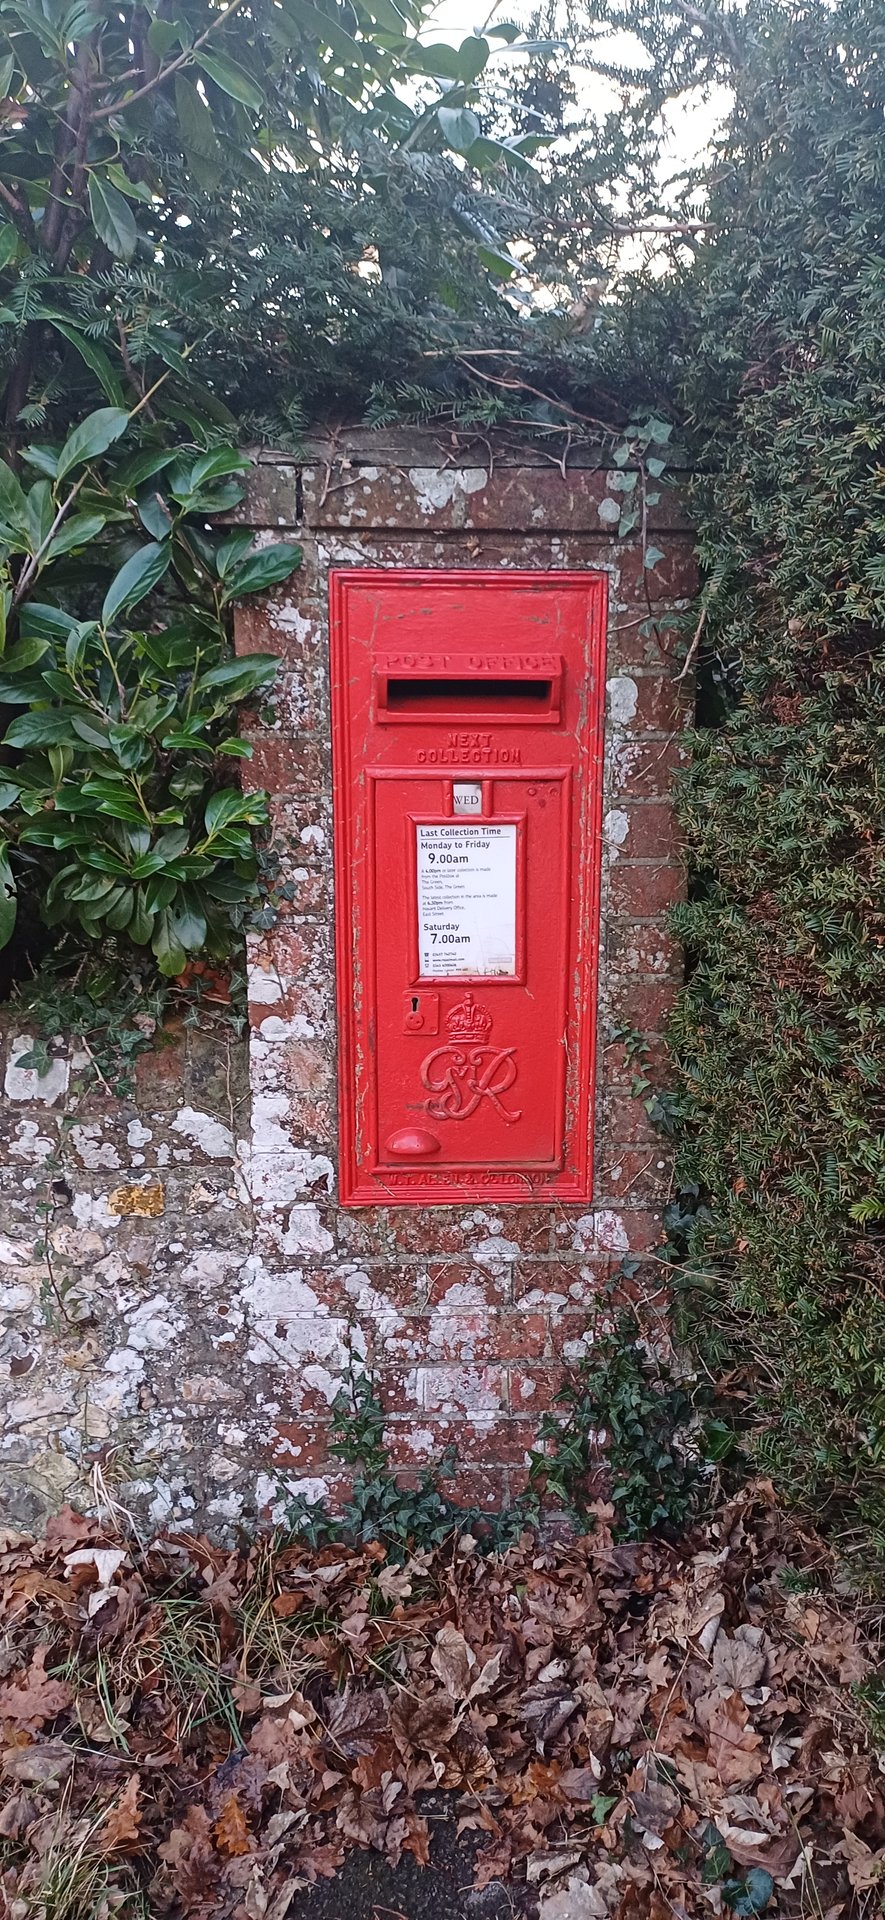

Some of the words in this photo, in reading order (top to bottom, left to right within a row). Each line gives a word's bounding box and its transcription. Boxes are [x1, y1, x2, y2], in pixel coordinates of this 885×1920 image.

[384, 655, 452, 670] POST
[468, 655, 557, 671] OFFICE
[448, 732, 493, 748] NEXT
[416, 749, 522, 764] COLLECTION
[453, 795, 479, 805] WED
[420, 829, 438, 837] Last
[440, 828, 479, 837] Collection
[481, 827, 502, 836] Time
[421, 842, 452, 850] Monday
[466, 841, 490, 849] Friday
[428, 852, 469, 864] 9.00am
[423, 923, 460, 932] Saturday
[430, 933, 471, 945] 7.00am
